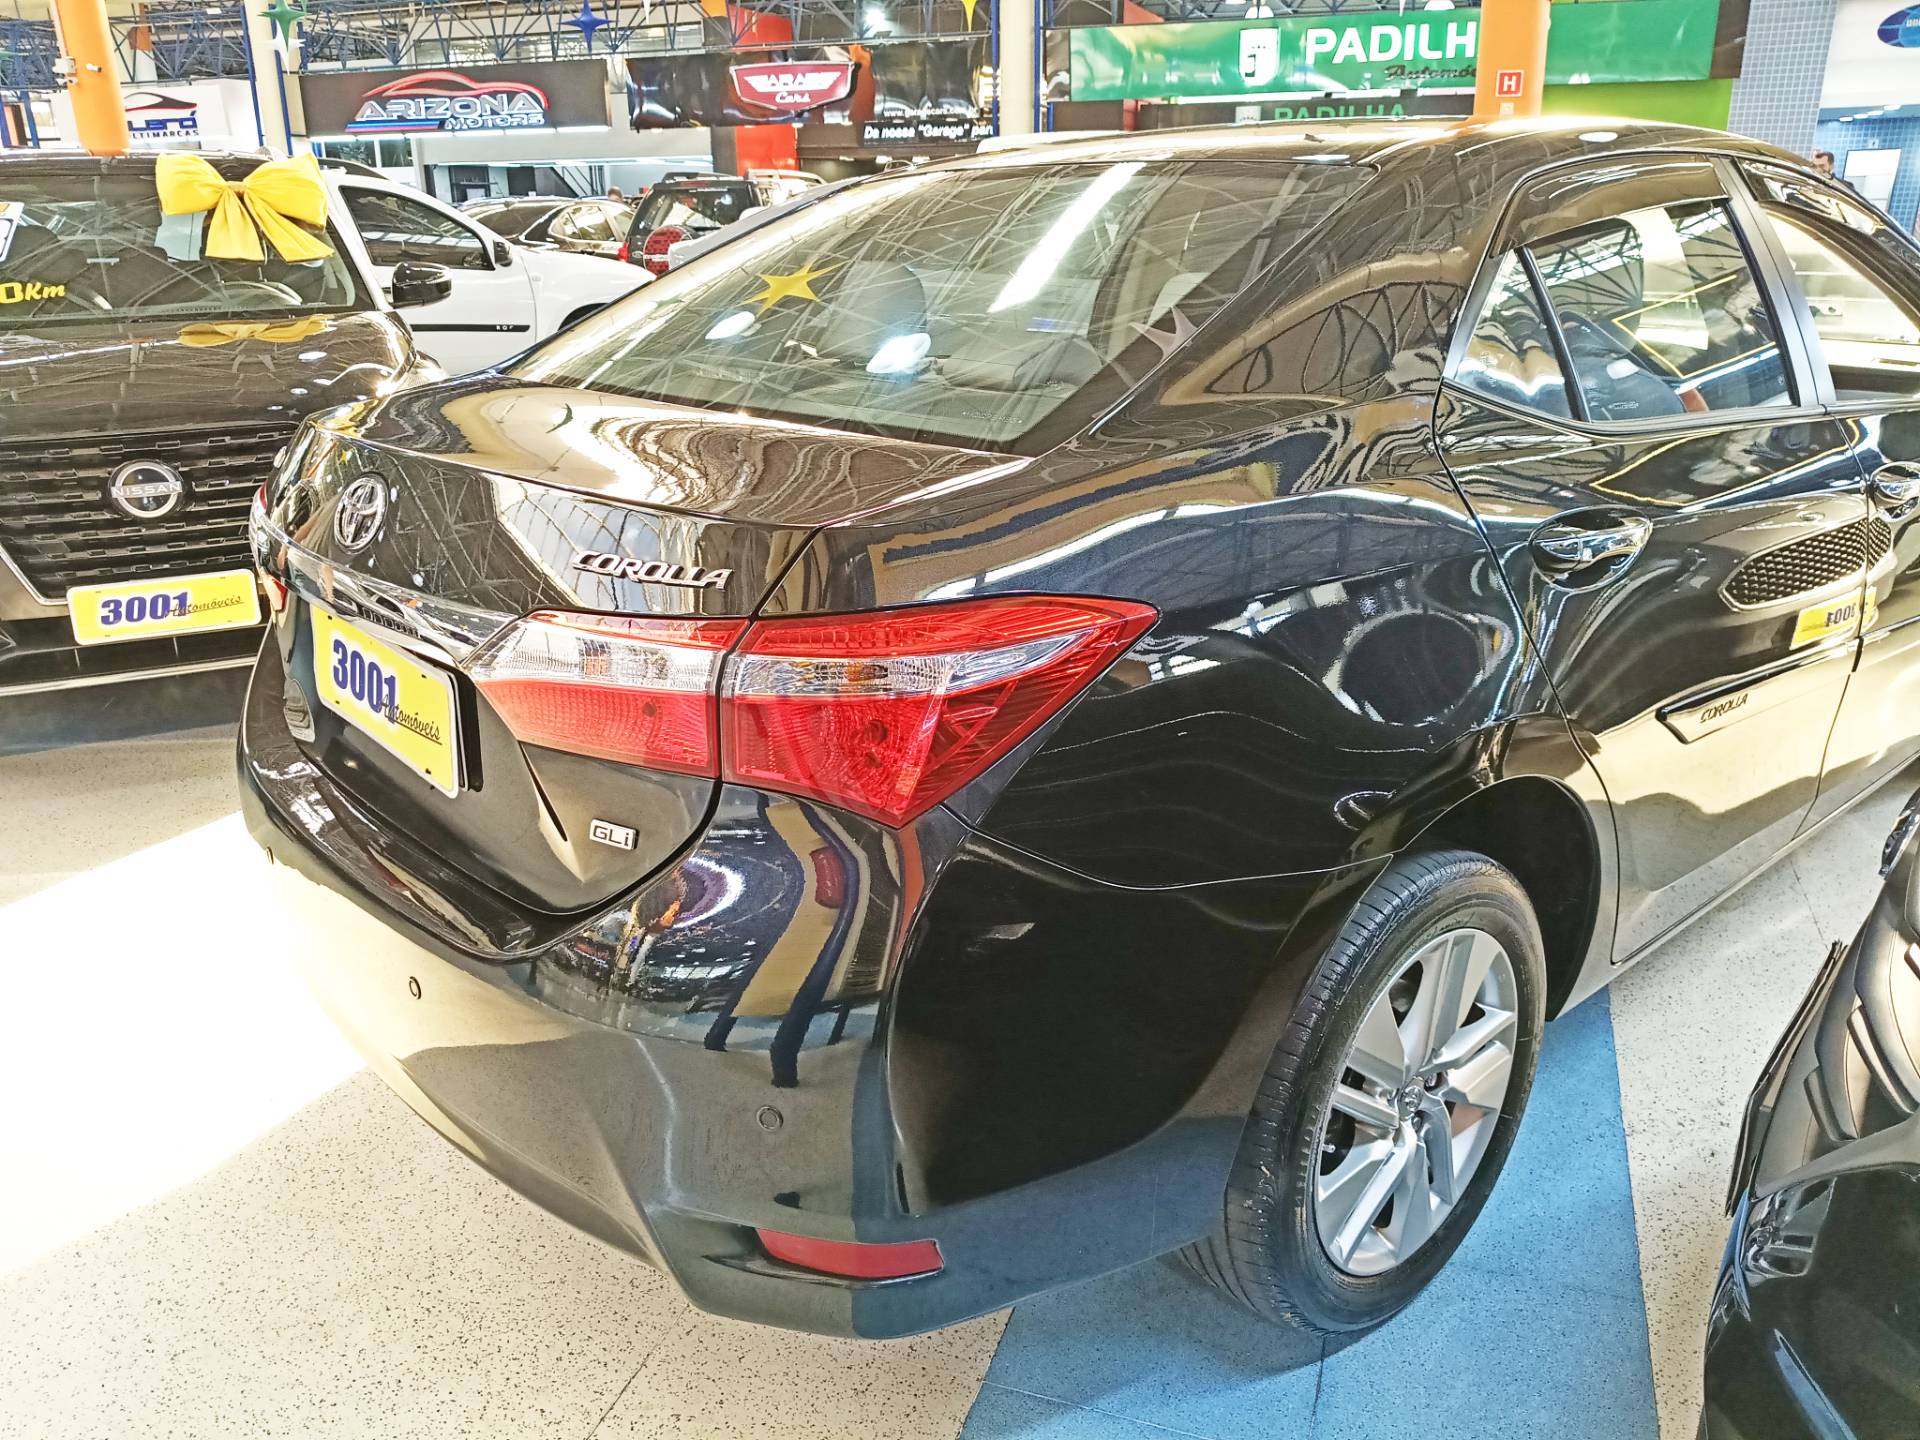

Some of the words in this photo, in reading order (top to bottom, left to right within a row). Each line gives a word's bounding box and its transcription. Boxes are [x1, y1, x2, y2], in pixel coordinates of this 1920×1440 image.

[1305, 21, 1477, 64] PADILH
[1384, 64, 1477, 80] Automó
[1503, 75, 1517, 91] H
[354, 91, 545, 121] ARIZONA
[132, 129, 199, 140] LTIMARCAS
[443, 113, 545, 130] MOTORS
[111, 481, 182, 497] NISSAN
[572, 550, 734, 591] COROLLA
[100, 591, 189, 626] 3001
[333, 638, 396, 724] 3001
[1700, 693, 1748, 723] COROLLA
[593, 824, 630, 847] GLi
